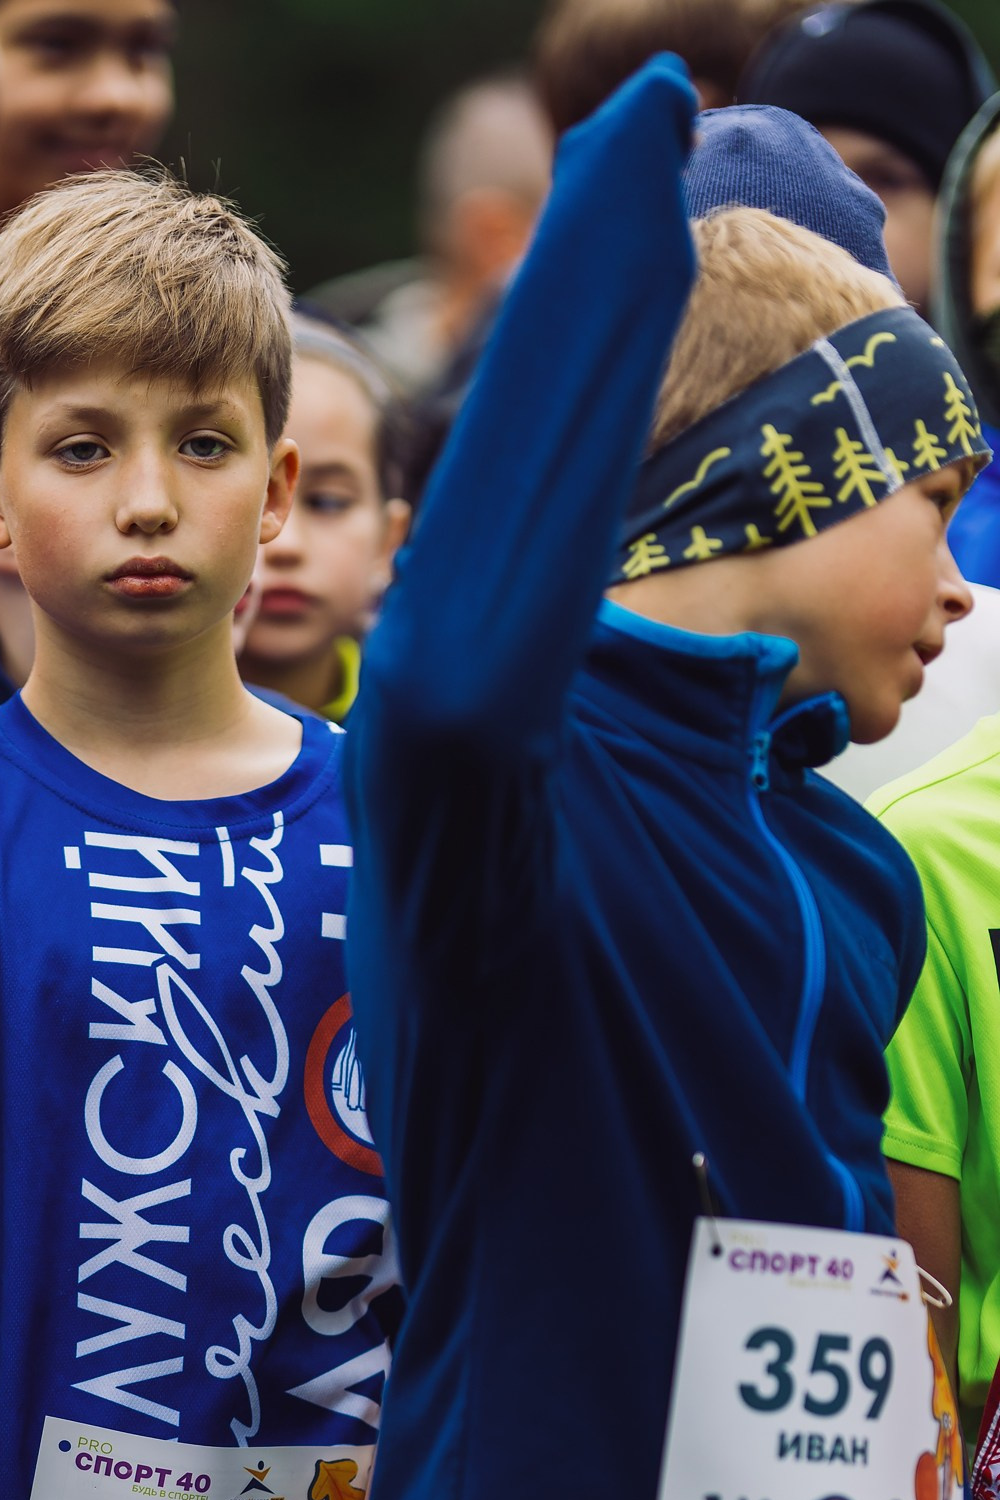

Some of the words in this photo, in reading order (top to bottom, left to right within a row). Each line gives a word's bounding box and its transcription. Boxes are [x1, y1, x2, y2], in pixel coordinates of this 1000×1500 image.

[727, 1249, 820, 1278] СПОРТ
[826, 1256, 855, 1282] 40
[738, 1326, 894, 1421] 359
[77, 1437, 113, 1454] PRO
[776, 1431, 869, 1466] ИВАН
[75, 1452, 172, 1488] СПОРТ
[176, 1472, 212, 1493] 40
[131, 1484, 157, 1497] БУДЬ
